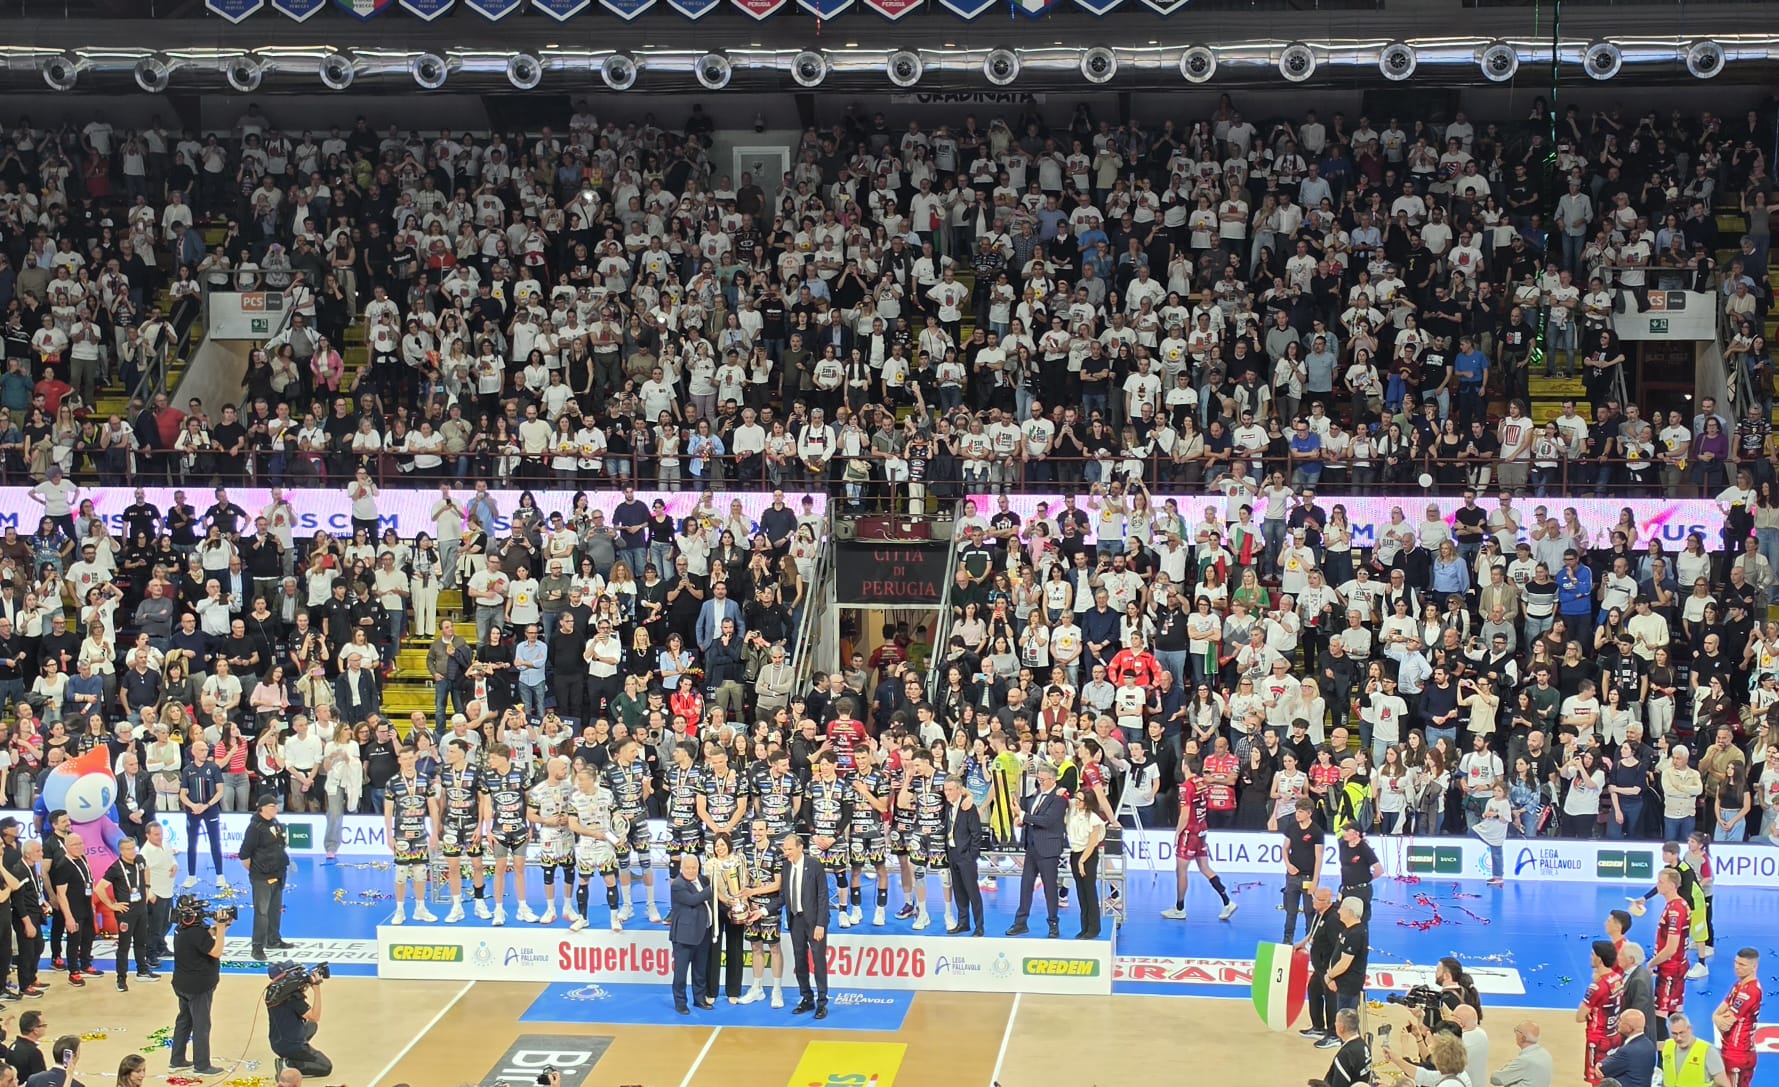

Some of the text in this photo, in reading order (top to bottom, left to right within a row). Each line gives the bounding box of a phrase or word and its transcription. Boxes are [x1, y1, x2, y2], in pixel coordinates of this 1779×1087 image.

[243, 297, 263, 307] PCS
[1648, 296, 1664, 306] CS
[892, 566, 905, 576] DI
[862, 581, 936, 596] PERUGIA
[1540, 848, 1559, 858] LEGA
[1539, 858, 1582, 870] PALLAVOLO
[393, 946, 458, 960] CREDEM
[558, 941, 675, 976] SuperLeg
[807, 945, 926, 978] 25/2026
[1027, 959, 1094, 975] CREDEM
[1276, 967, 1283, 983] 3
